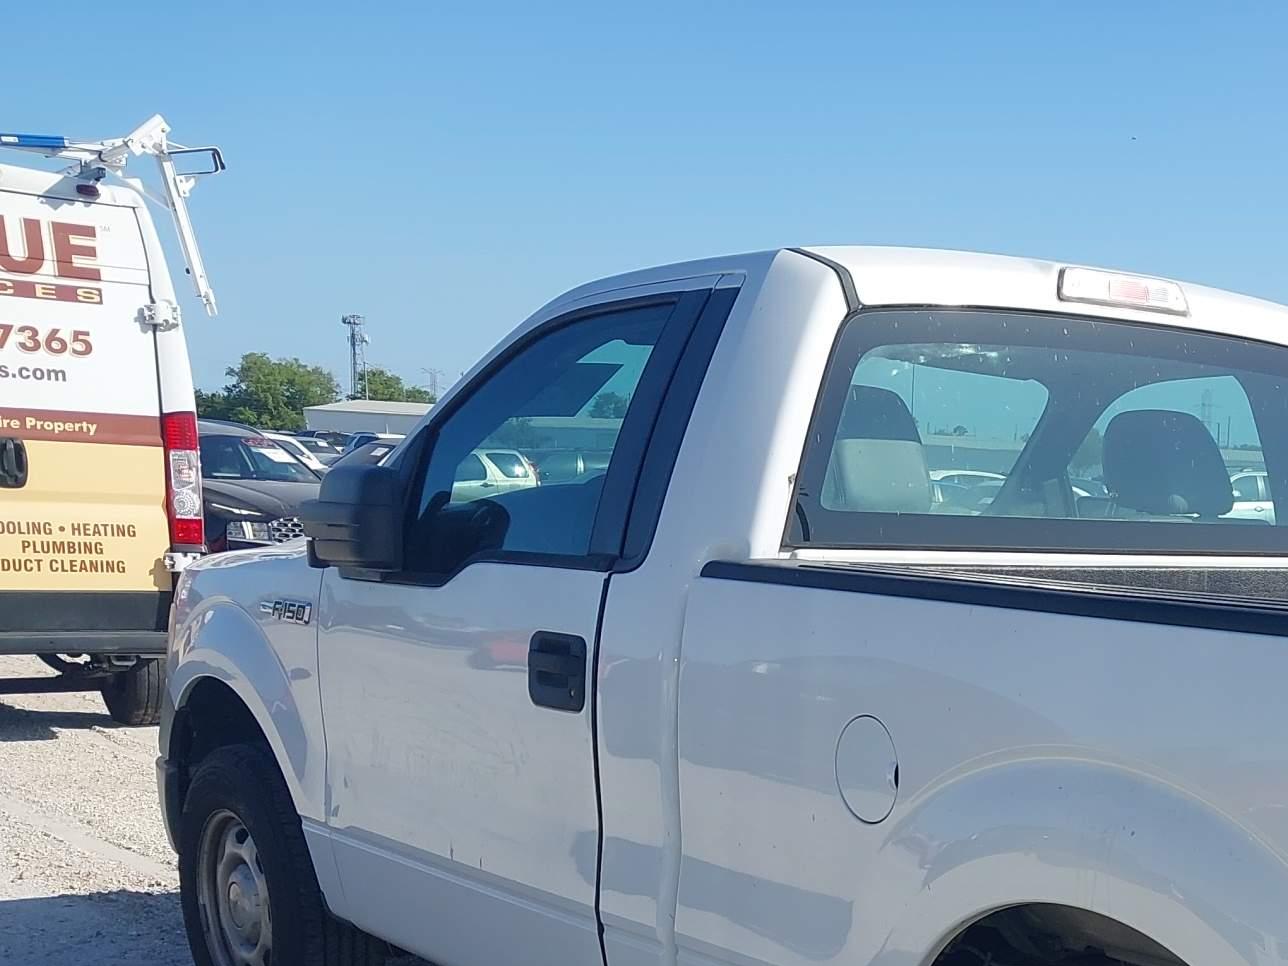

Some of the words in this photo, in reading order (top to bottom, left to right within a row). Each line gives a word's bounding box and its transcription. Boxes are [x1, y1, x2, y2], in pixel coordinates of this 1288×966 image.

[0, 323, 93, 356] 7365
[0, 364, 67, 382] s.com
[25, 416, 97, 436] Property
[71, 522, 137, 538] HEATING
[21, 540, 104, 555] PLUMBING
[1, 558, 43, 572] DUCT
[49, 559, 126, 574] CLEANING
